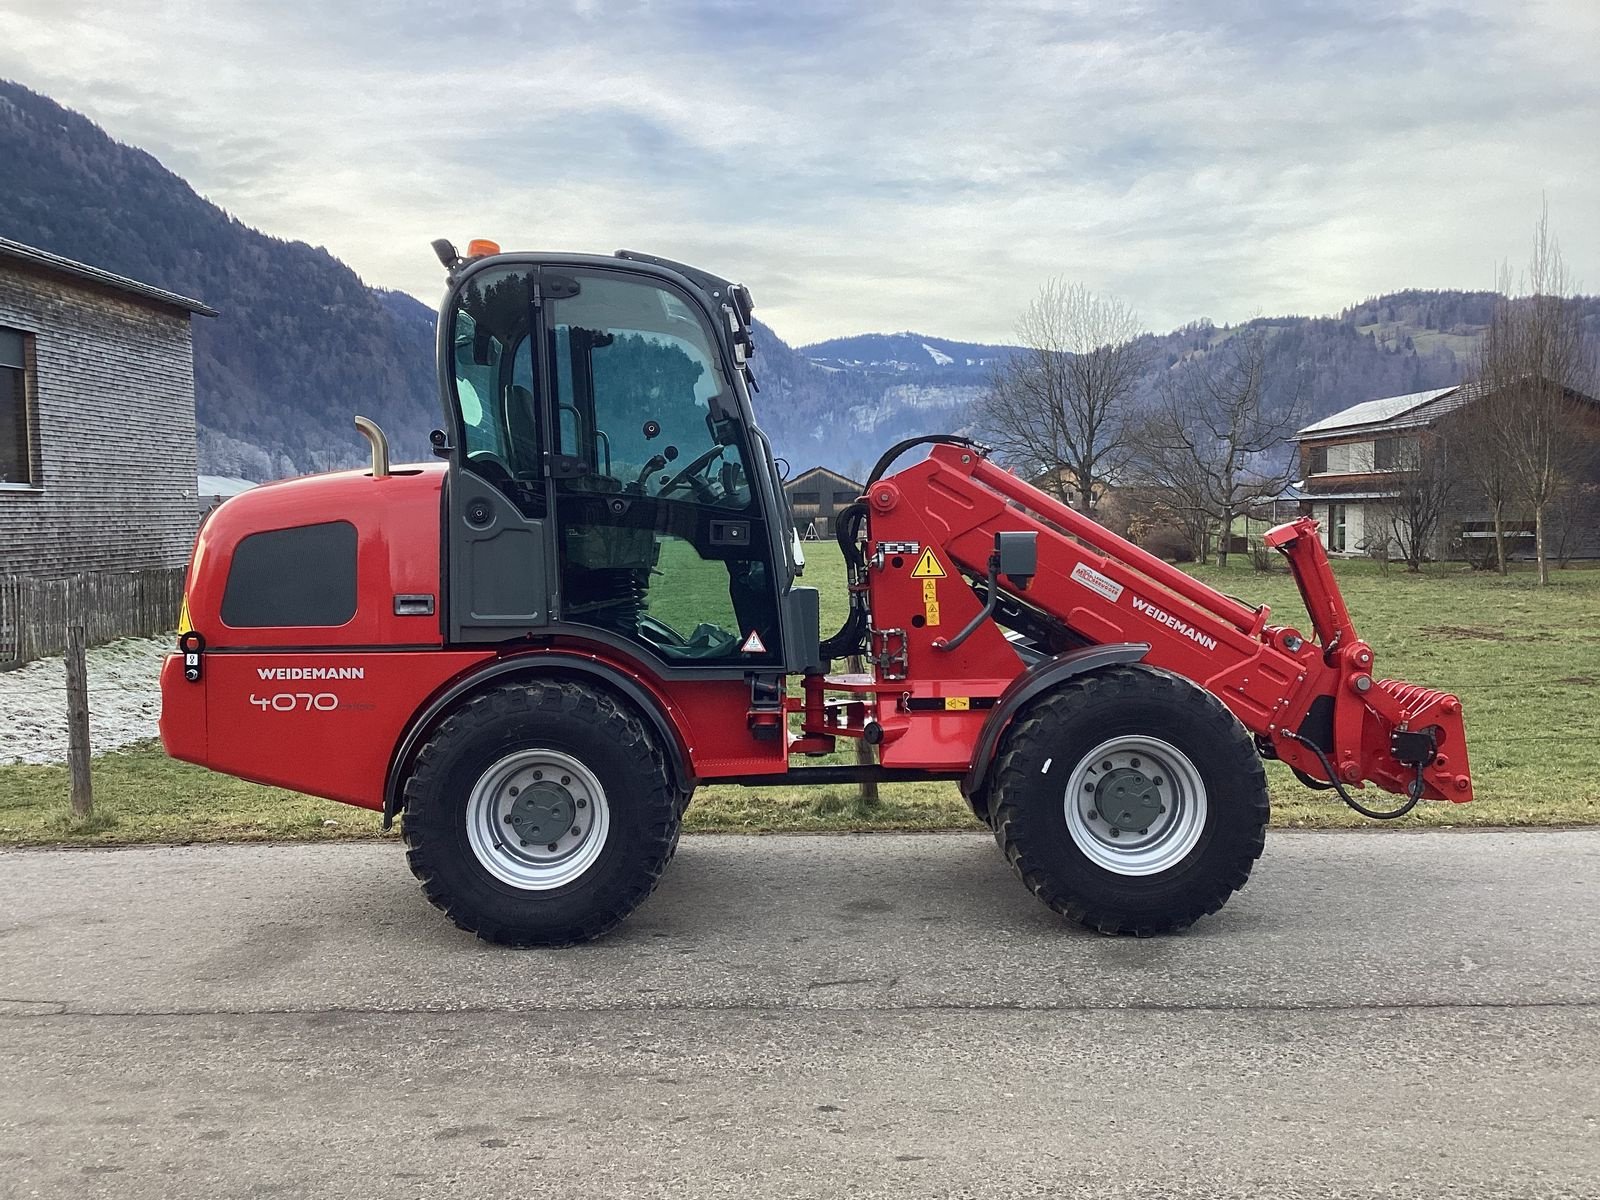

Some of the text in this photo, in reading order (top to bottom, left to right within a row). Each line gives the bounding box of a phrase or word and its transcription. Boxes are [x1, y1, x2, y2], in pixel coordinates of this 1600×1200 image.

[1132, 596, 1218, 651] WEIDEMANN
[257, 667, 364, 680] WEIDEMANN
[249, 693, 339, 711] 4070
